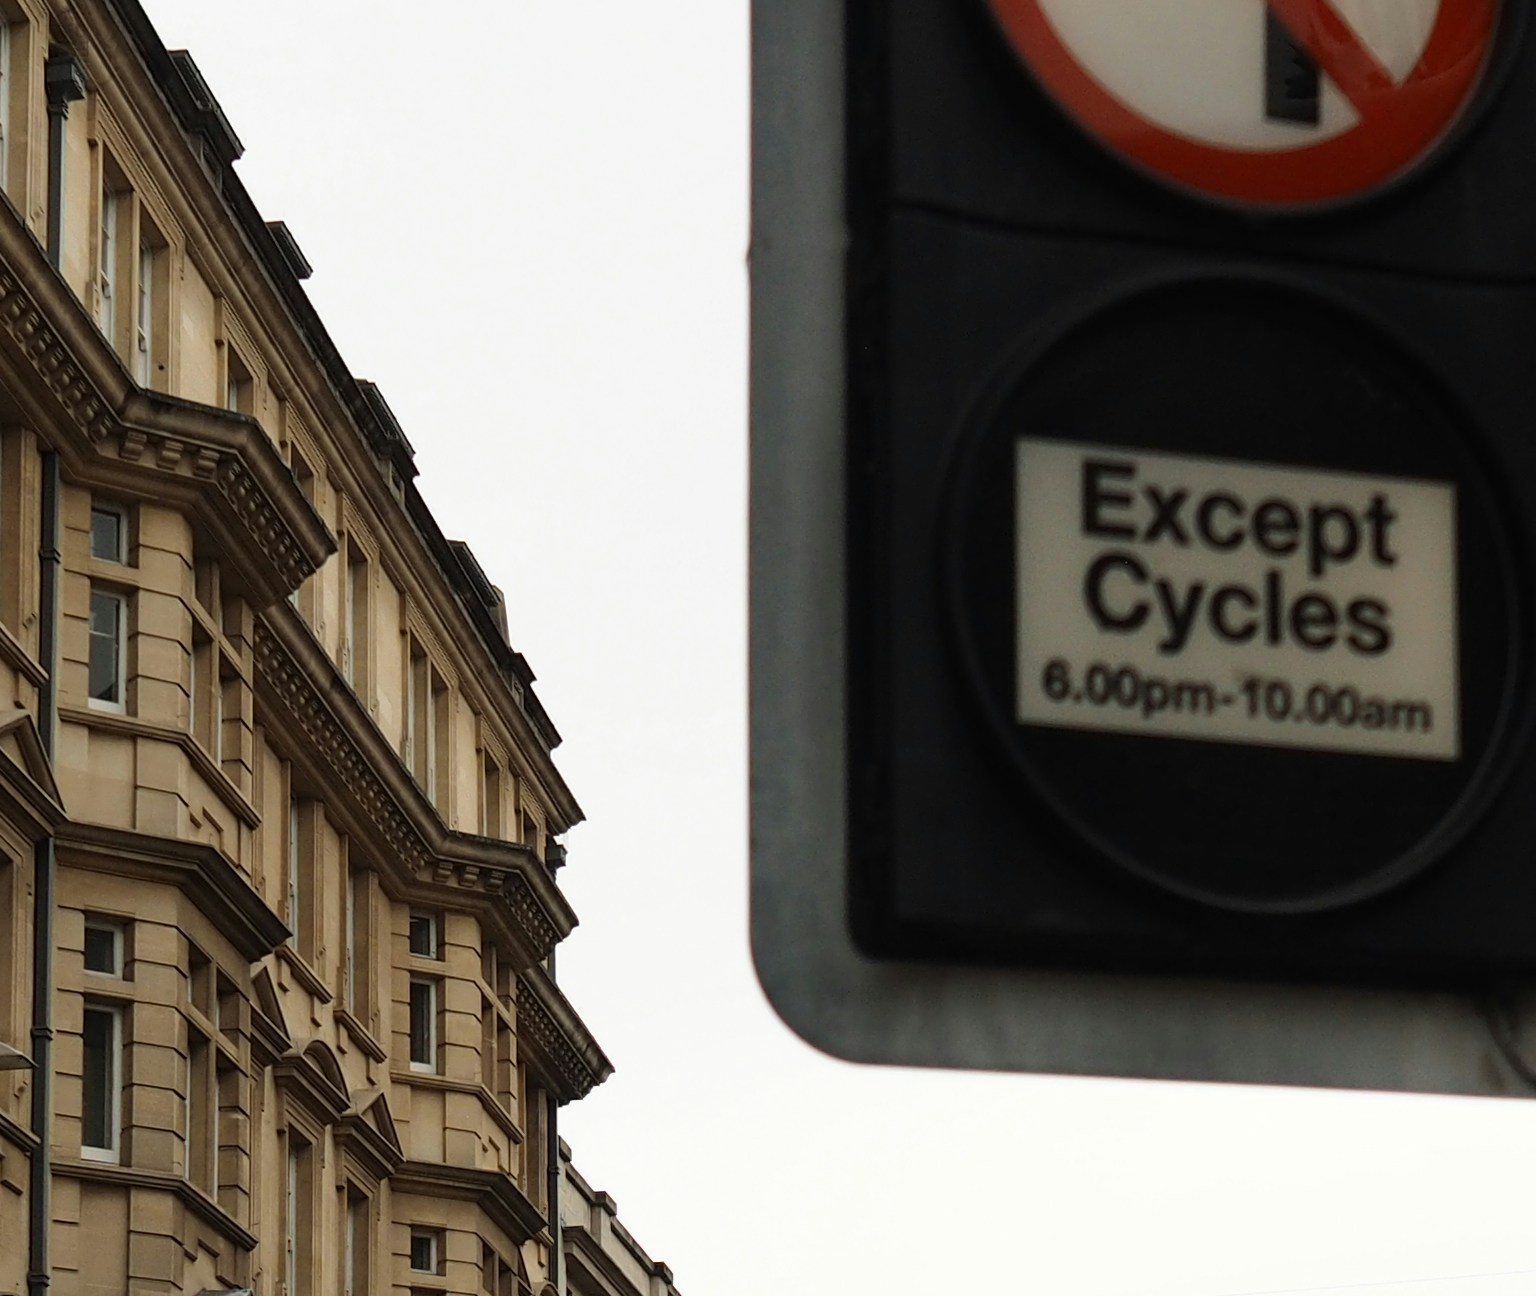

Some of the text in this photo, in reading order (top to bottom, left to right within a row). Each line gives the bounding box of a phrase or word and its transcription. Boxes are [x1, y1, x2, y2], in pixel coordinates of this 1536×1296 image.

[1083, 459, 1396, 575] Except
[1084, 552, 1391, 655] Cycles
[1043, 660, 1433, 732] 6.00pm-10.00am
